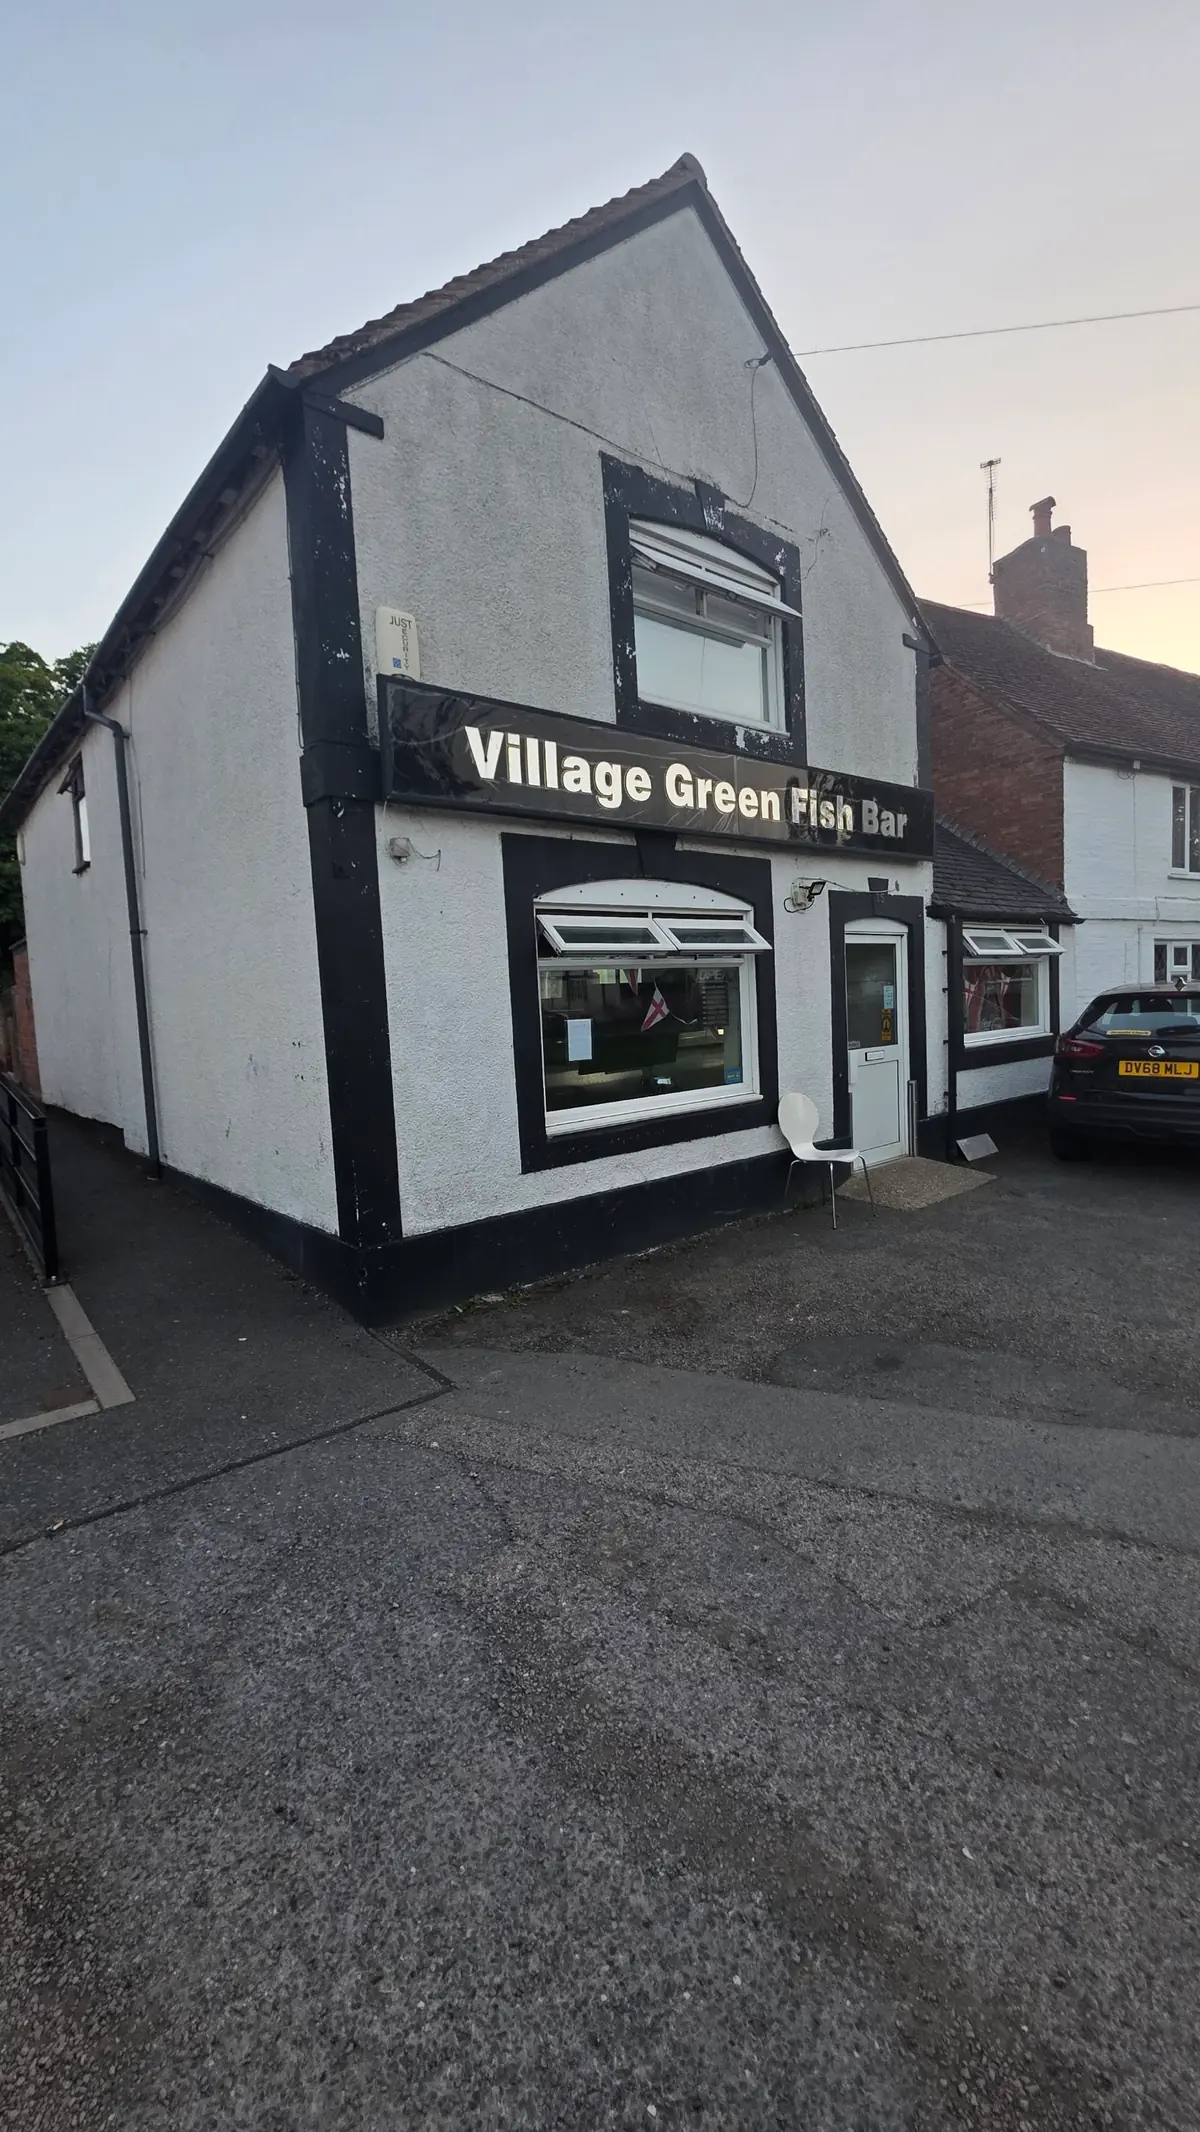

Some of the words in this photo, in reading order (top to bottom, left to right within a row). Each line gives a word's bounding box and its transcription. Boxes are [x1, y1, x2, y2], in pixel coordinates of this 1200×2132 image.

[389, 615, 412, 629] JUST
[464, 726, 651, 809] Village
[665, 763, 781, 821] Green
[791, 787, 854, 831] Fish
[862, 799, 908, 838] Bar
[1125, 1062, 1160, 1074] DV68
[1164, 1063, 1193, 1075] MLJ
